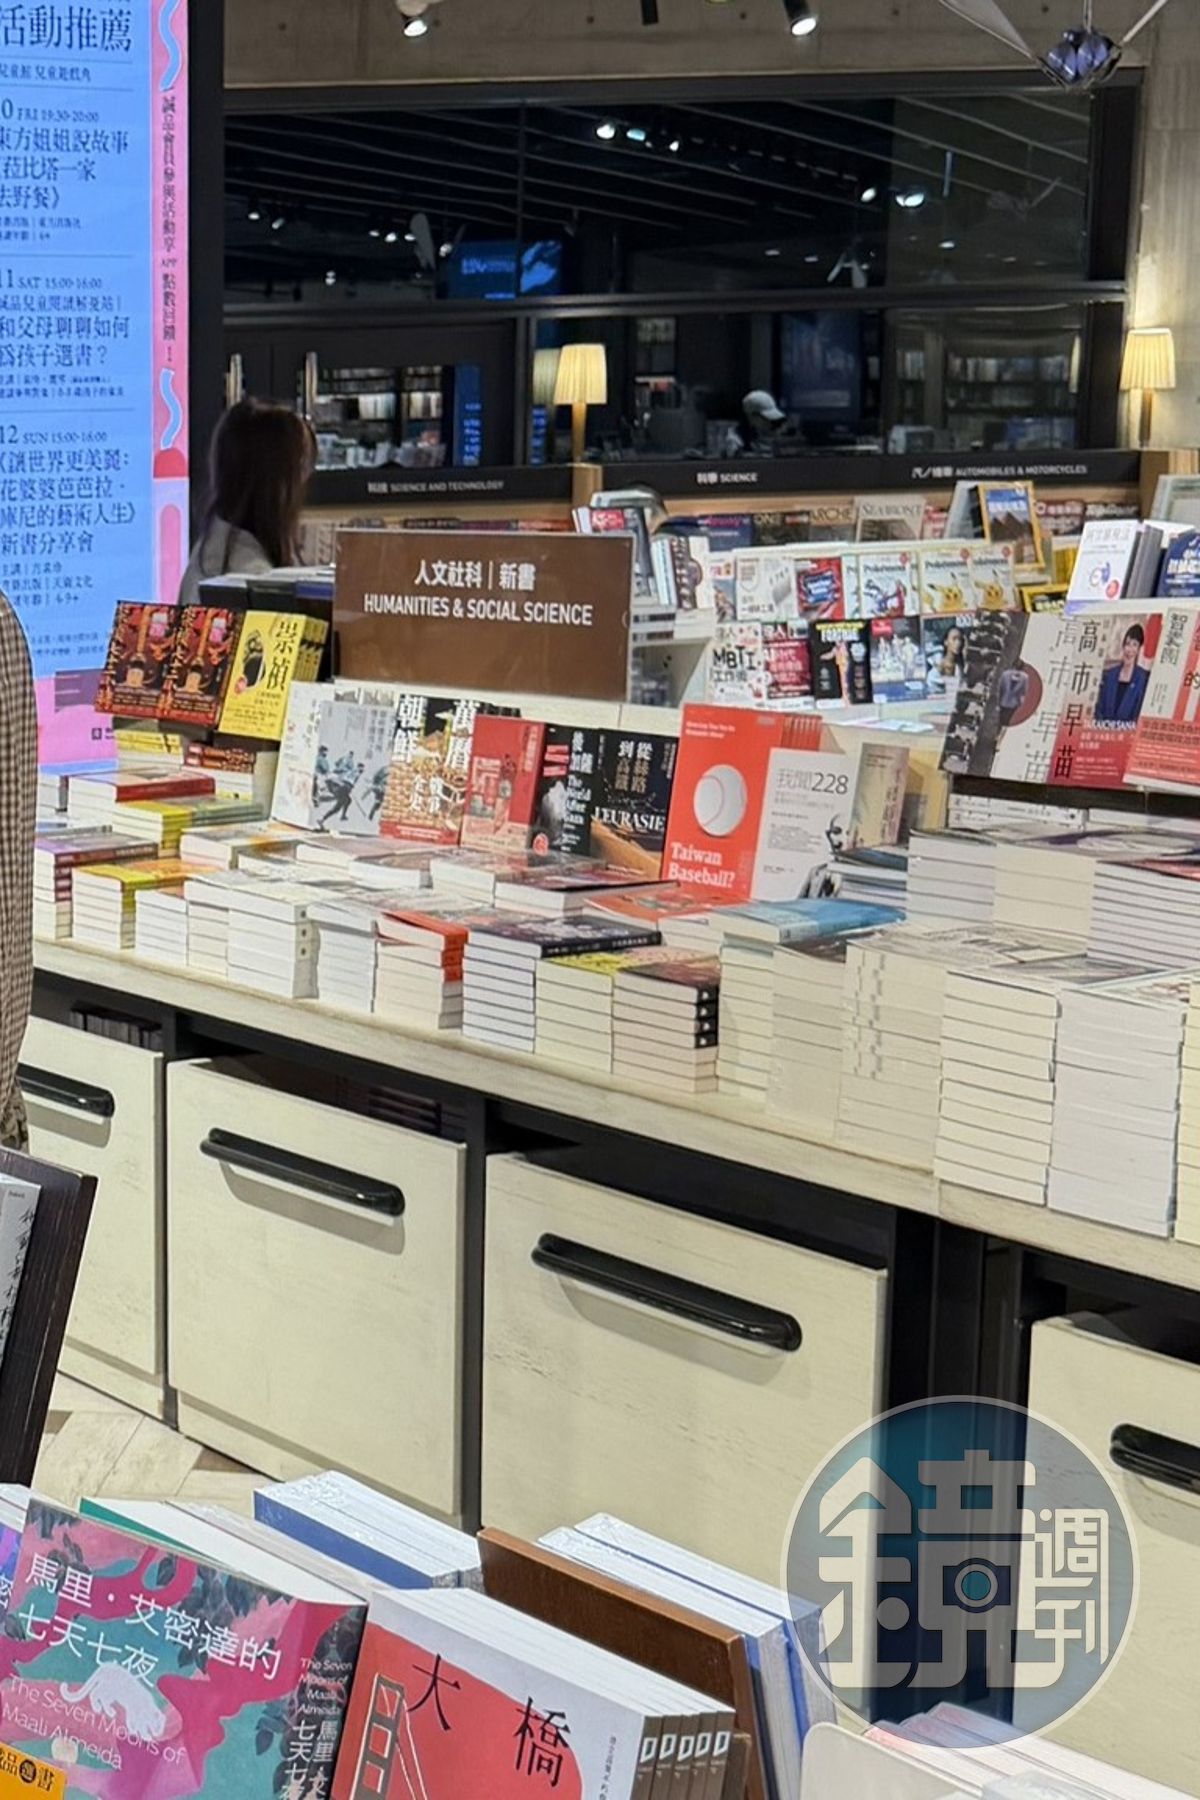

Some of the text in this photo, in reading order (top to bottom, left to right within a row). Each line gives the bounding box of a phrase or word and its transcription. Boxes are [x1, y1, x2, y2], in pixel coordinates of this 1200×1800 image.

[17, 276, 42, 289] SAT
[0, 316, 130, 339] 和父母聊聊如何
[23, 433, 49, 445] SUN
[720, 472, 757, 483] SCIENCE
[0, 532, 94, 556] 新書分享會
[414, 560, 536, 592] 人文社科 新書
[364, 593, 593, 627] HUMANITIES & SOCIAL SCIENCE
[1053, 620, 1102, 779] 高市早苗
[390, 693, 429, 763] 朝鮮
[669, 842, 723, 867] Taiwan
[667, 862, 736, 888] Baseball?
[24, 1552, 283, 1682] 馬里·艾密達的
[17, 1603, 160, 1689] 七天七夜
[299, 1657, 353, 1672] The Seven
[9, 1675, 189, 1767] The Seven Moons of
[407, 1653, 572, 1789] 大橋
[1, 1705, 123, 1772] Maali Almeida
